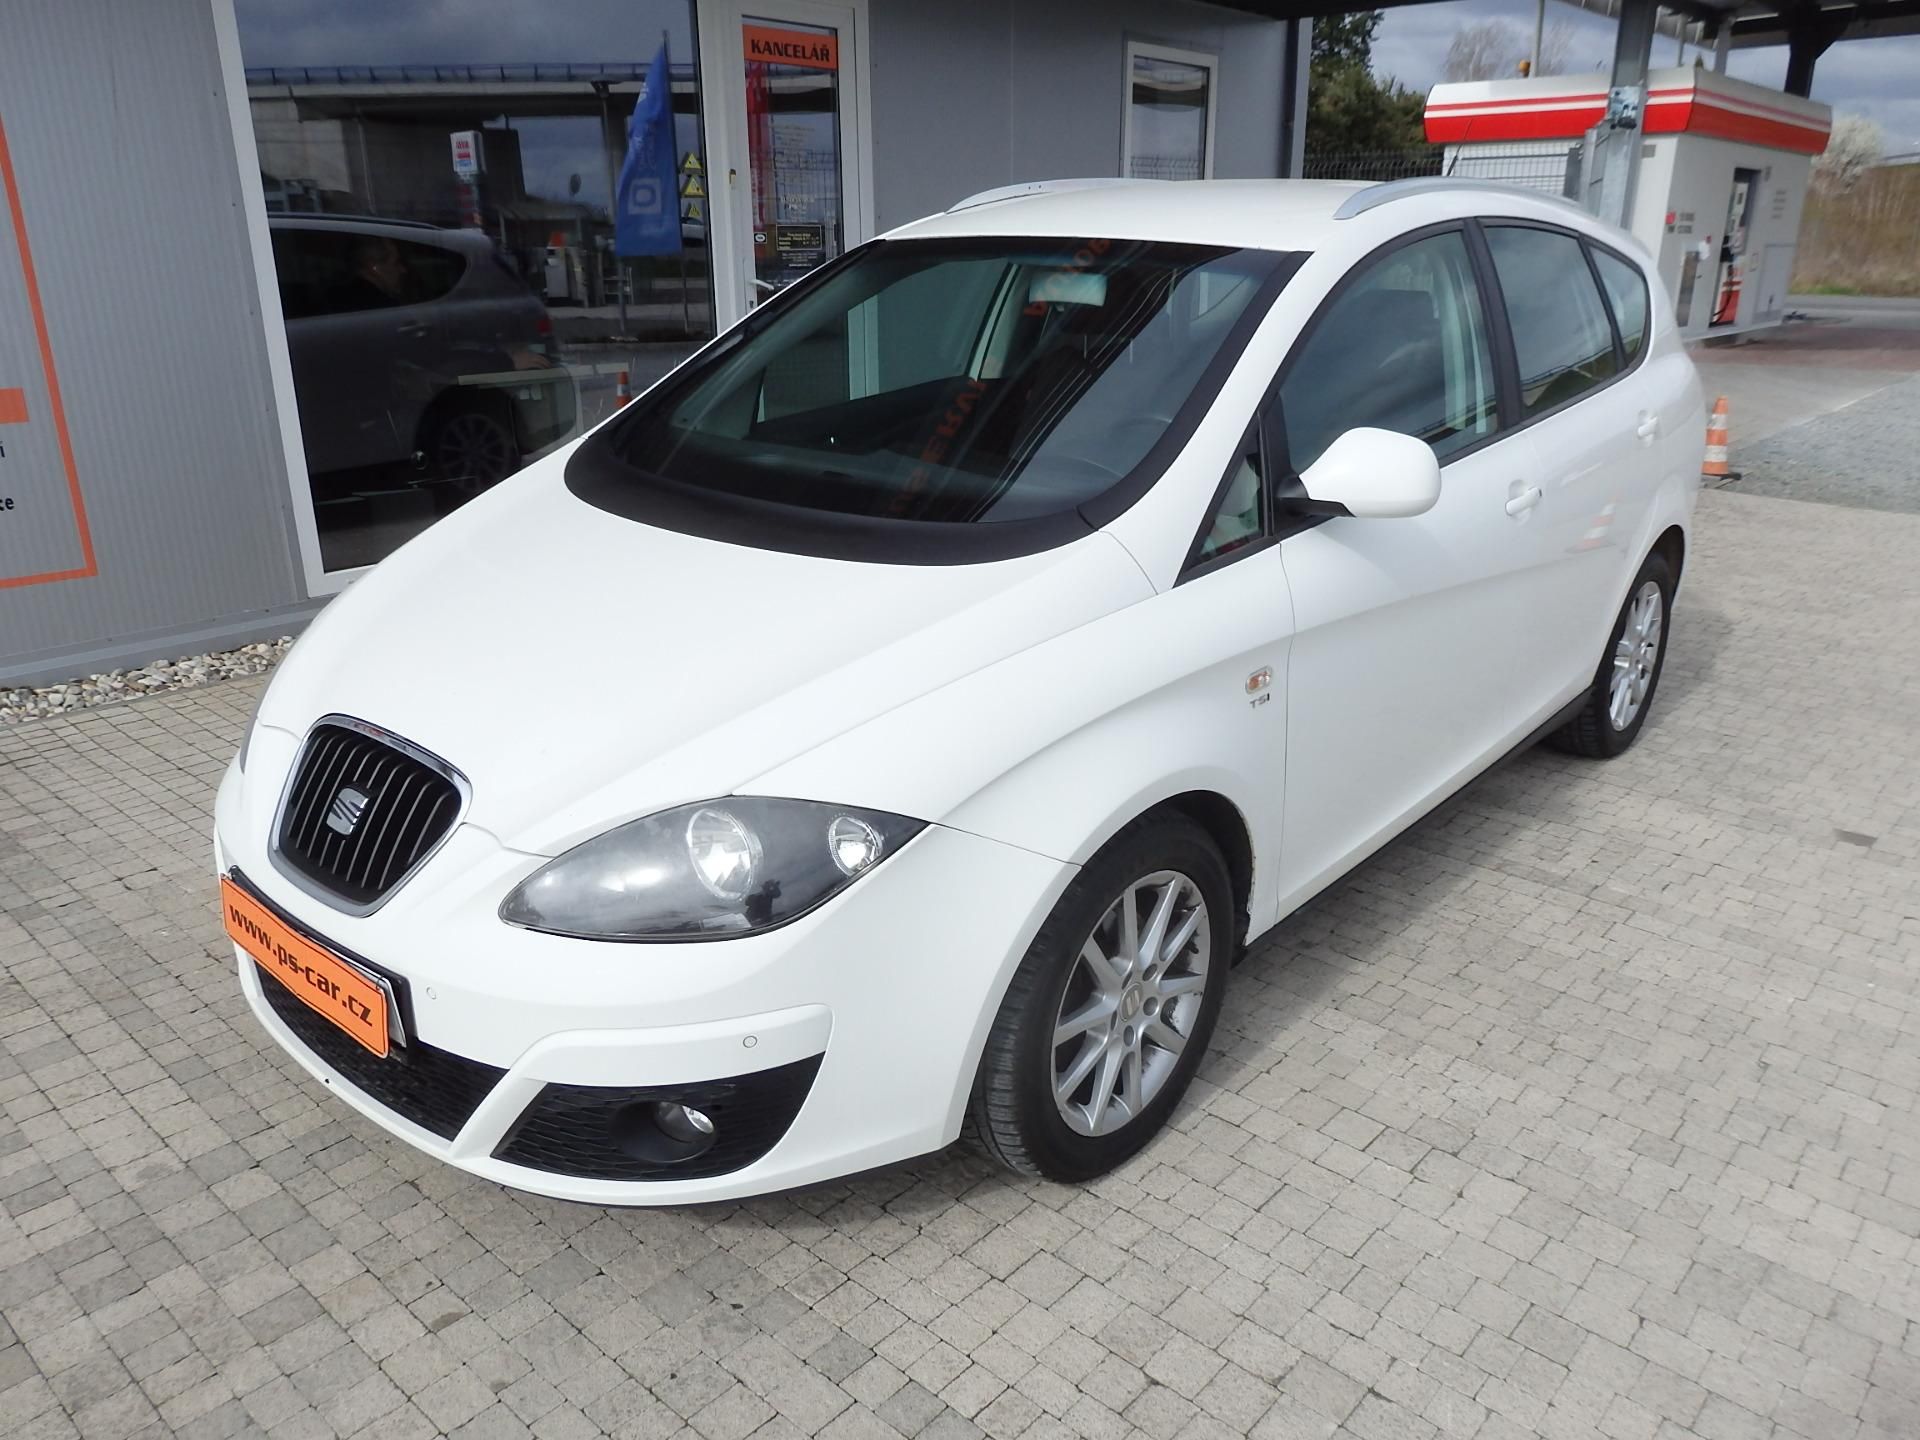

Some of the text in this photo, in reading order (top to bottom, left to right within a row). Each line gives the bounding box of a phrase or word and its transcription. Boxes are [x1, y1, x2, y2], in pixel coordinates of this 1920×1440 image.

[751, 39, 830, 62] KANCELÁŘ
[1250, 692, 1270, 709] TSI
[229, 905, 373, 1027] www.ps-car.cz
